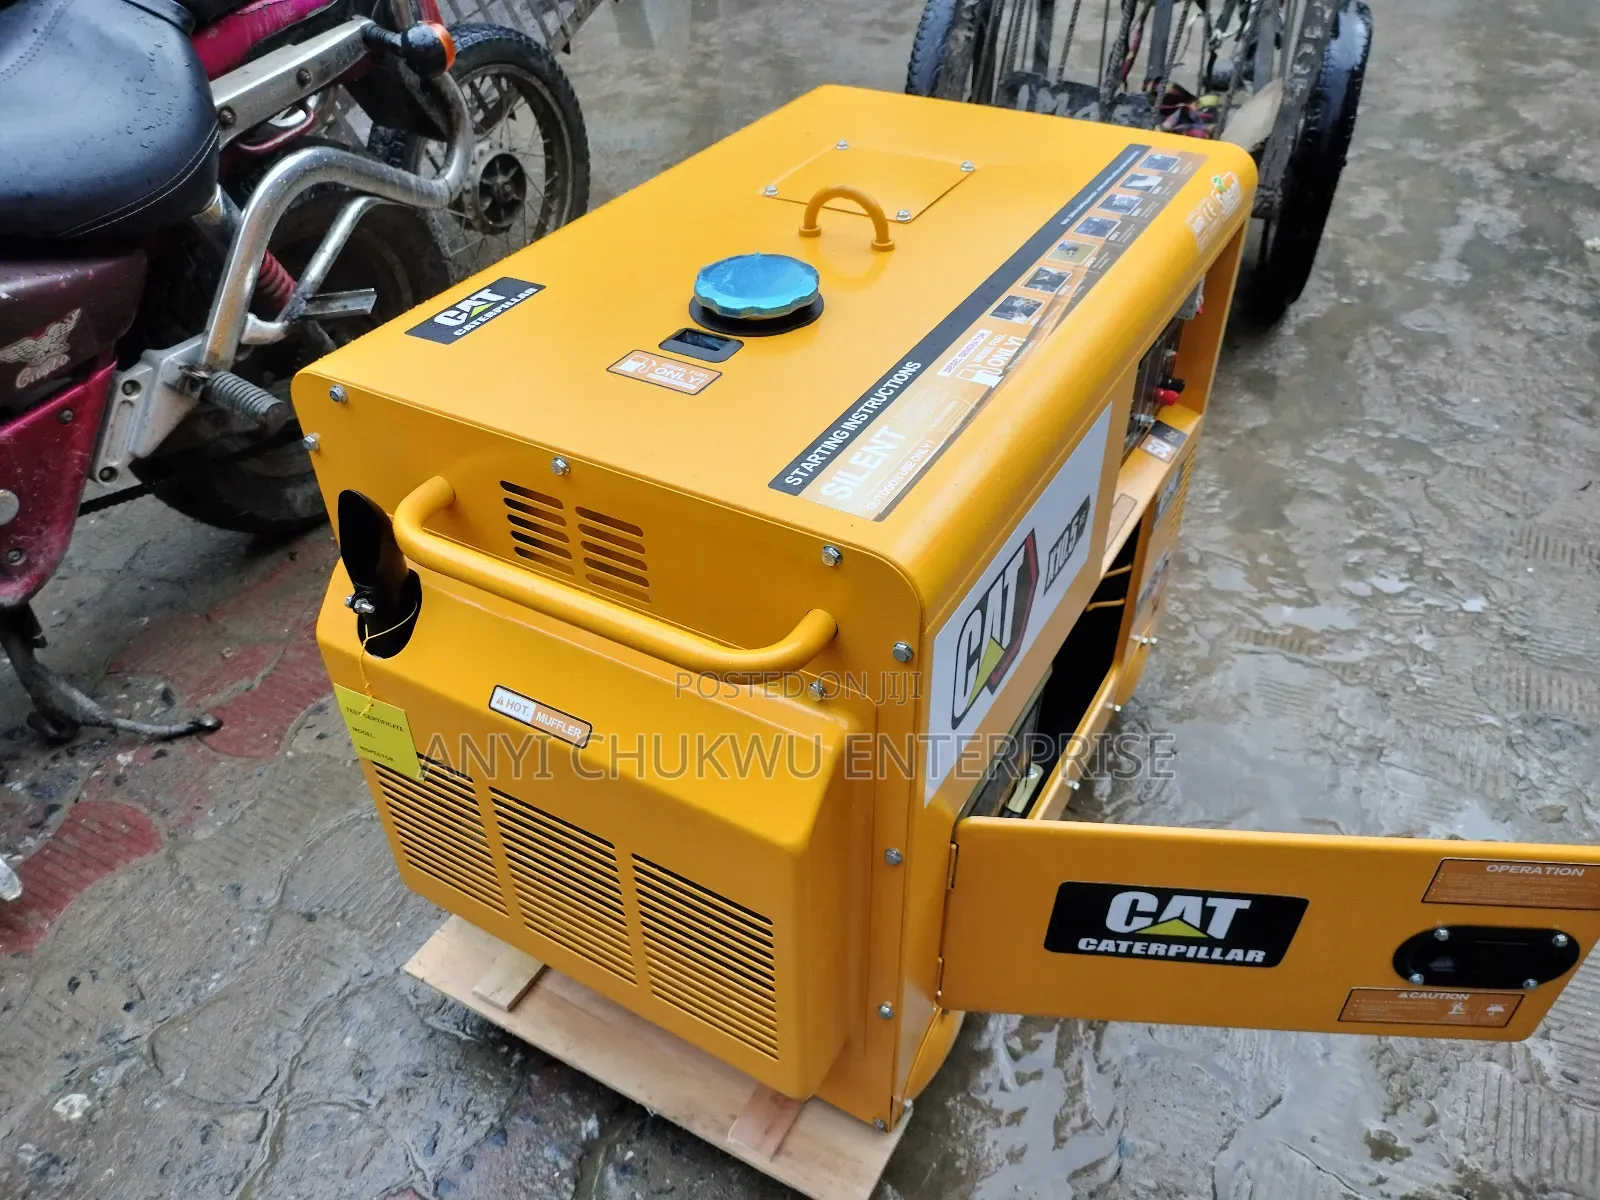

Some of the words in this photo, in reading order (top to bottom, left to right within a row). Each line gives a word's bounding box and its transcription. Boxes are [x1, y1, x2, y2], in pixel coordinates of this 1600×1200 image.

[434, 288, 506, 326] CAT
[453, 287, 538, 336] CATERPILLAR
[661, 362, 687, 373] DIESEL
[943, 358, 963, 374] DIESEL
[958, 332, 986, 359] GENERATOR
[987, 335, 1027, 368] ONLY!
[654, 367, 706, 386] ONLY!
[784, 429, 850, 487] STARTING
[841, 361, 922, 432] INSTRUCTIONS
[820, 425, 906, 500] SILENT
[866, 473, 904, 511] OUTDOOR
[900, 460, 917, 477] USE
[953, 541, 1026, 719] CAT
[346, 706, 361, 716] TEST
[363, 713, 404, 733] CERTIFICATE
[535, 711, 582, 738] MUFFLER
[1486, 864, 1585, 877] OPERATION
[1105, 890, 1252, 939] CAT
[1077, 937, 1266, 963] CATERPILLAR
[1409, 991, 1470, 1000] CAUTION
